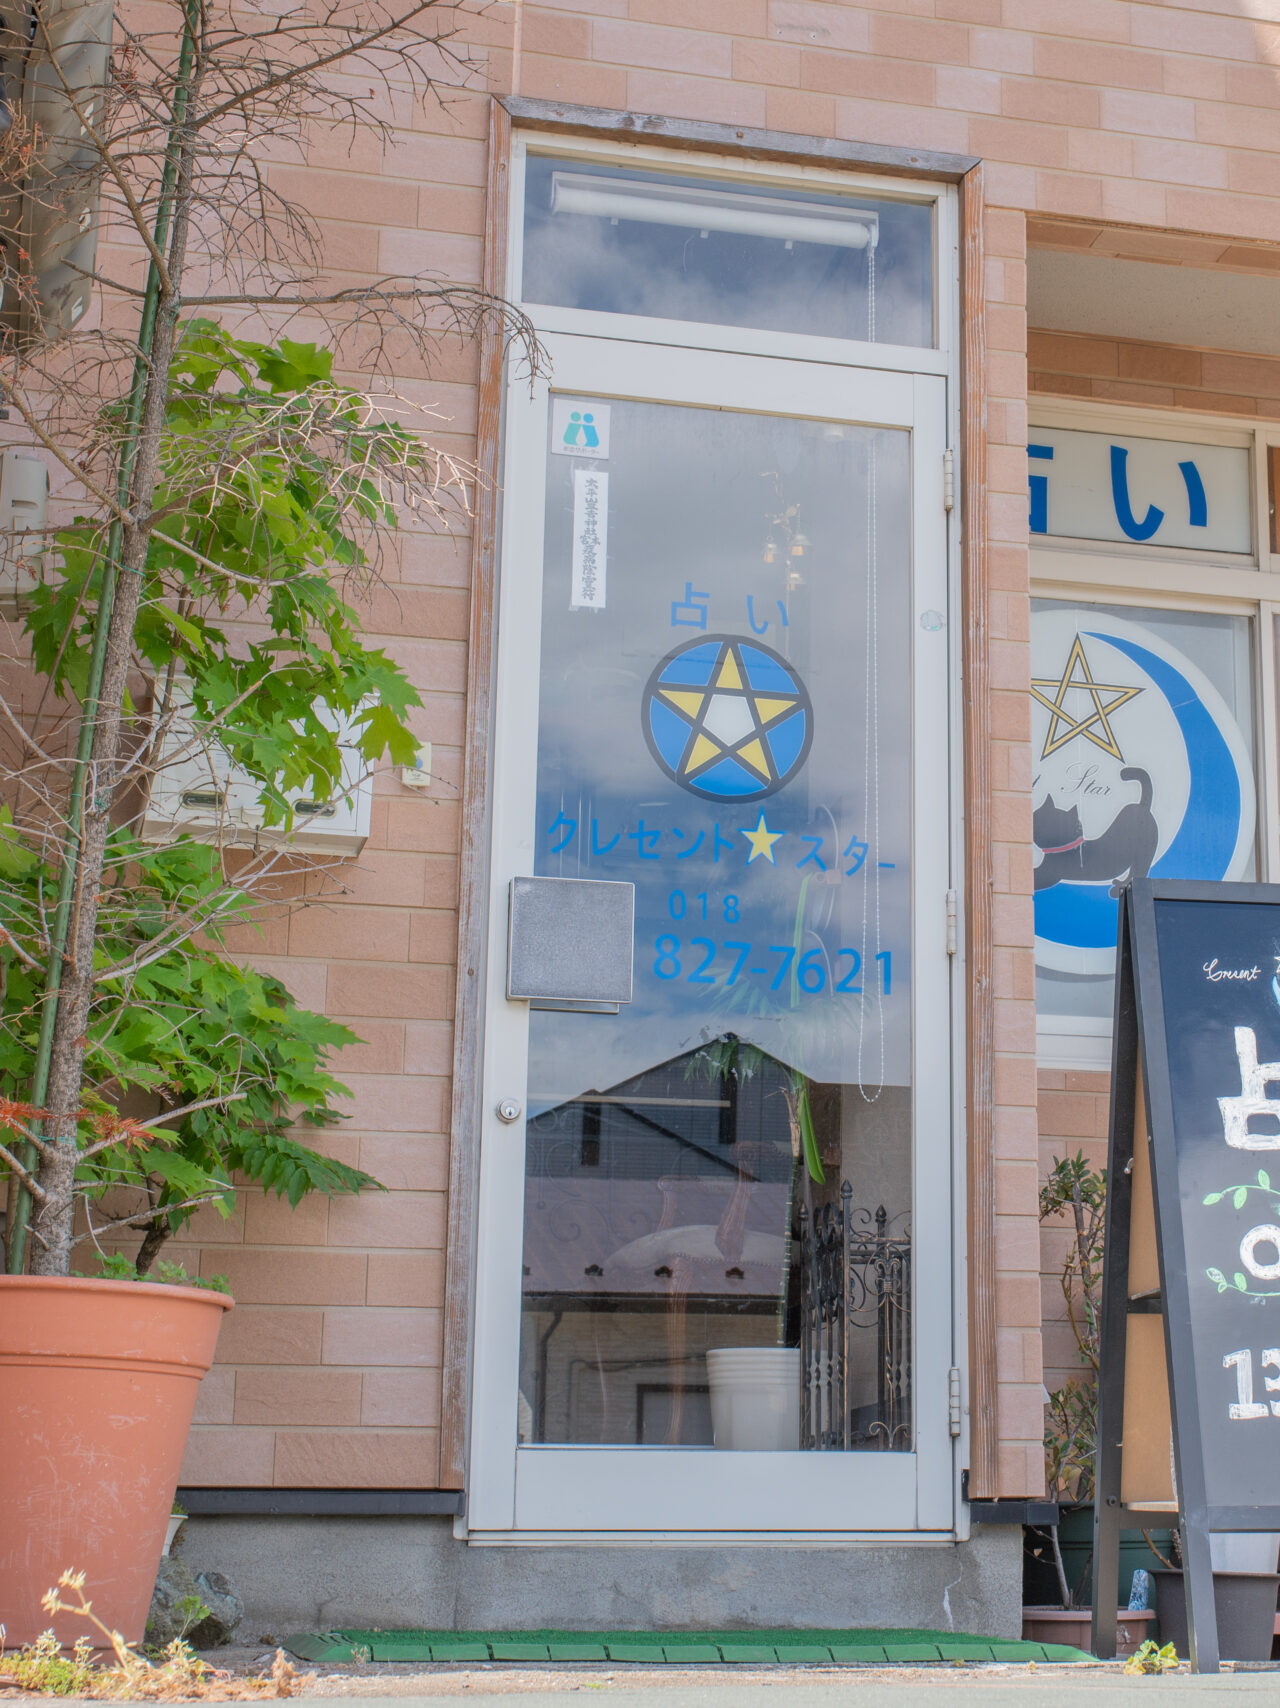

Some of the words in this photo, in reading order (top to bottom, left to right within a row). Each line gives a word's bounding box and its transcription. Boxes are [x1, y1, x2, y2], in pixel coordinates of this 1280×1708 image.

[1027, 444, 1208, 541] い
[670, 582, 789, 635] 占い
[1061, 762, 1112, 797] Star
[548, 811, 735, 863] クレセント
[796, 833, 896, 877] スター
[669, 889, 741, 924] 018
[653, 933, 893, 996] 827-7621
